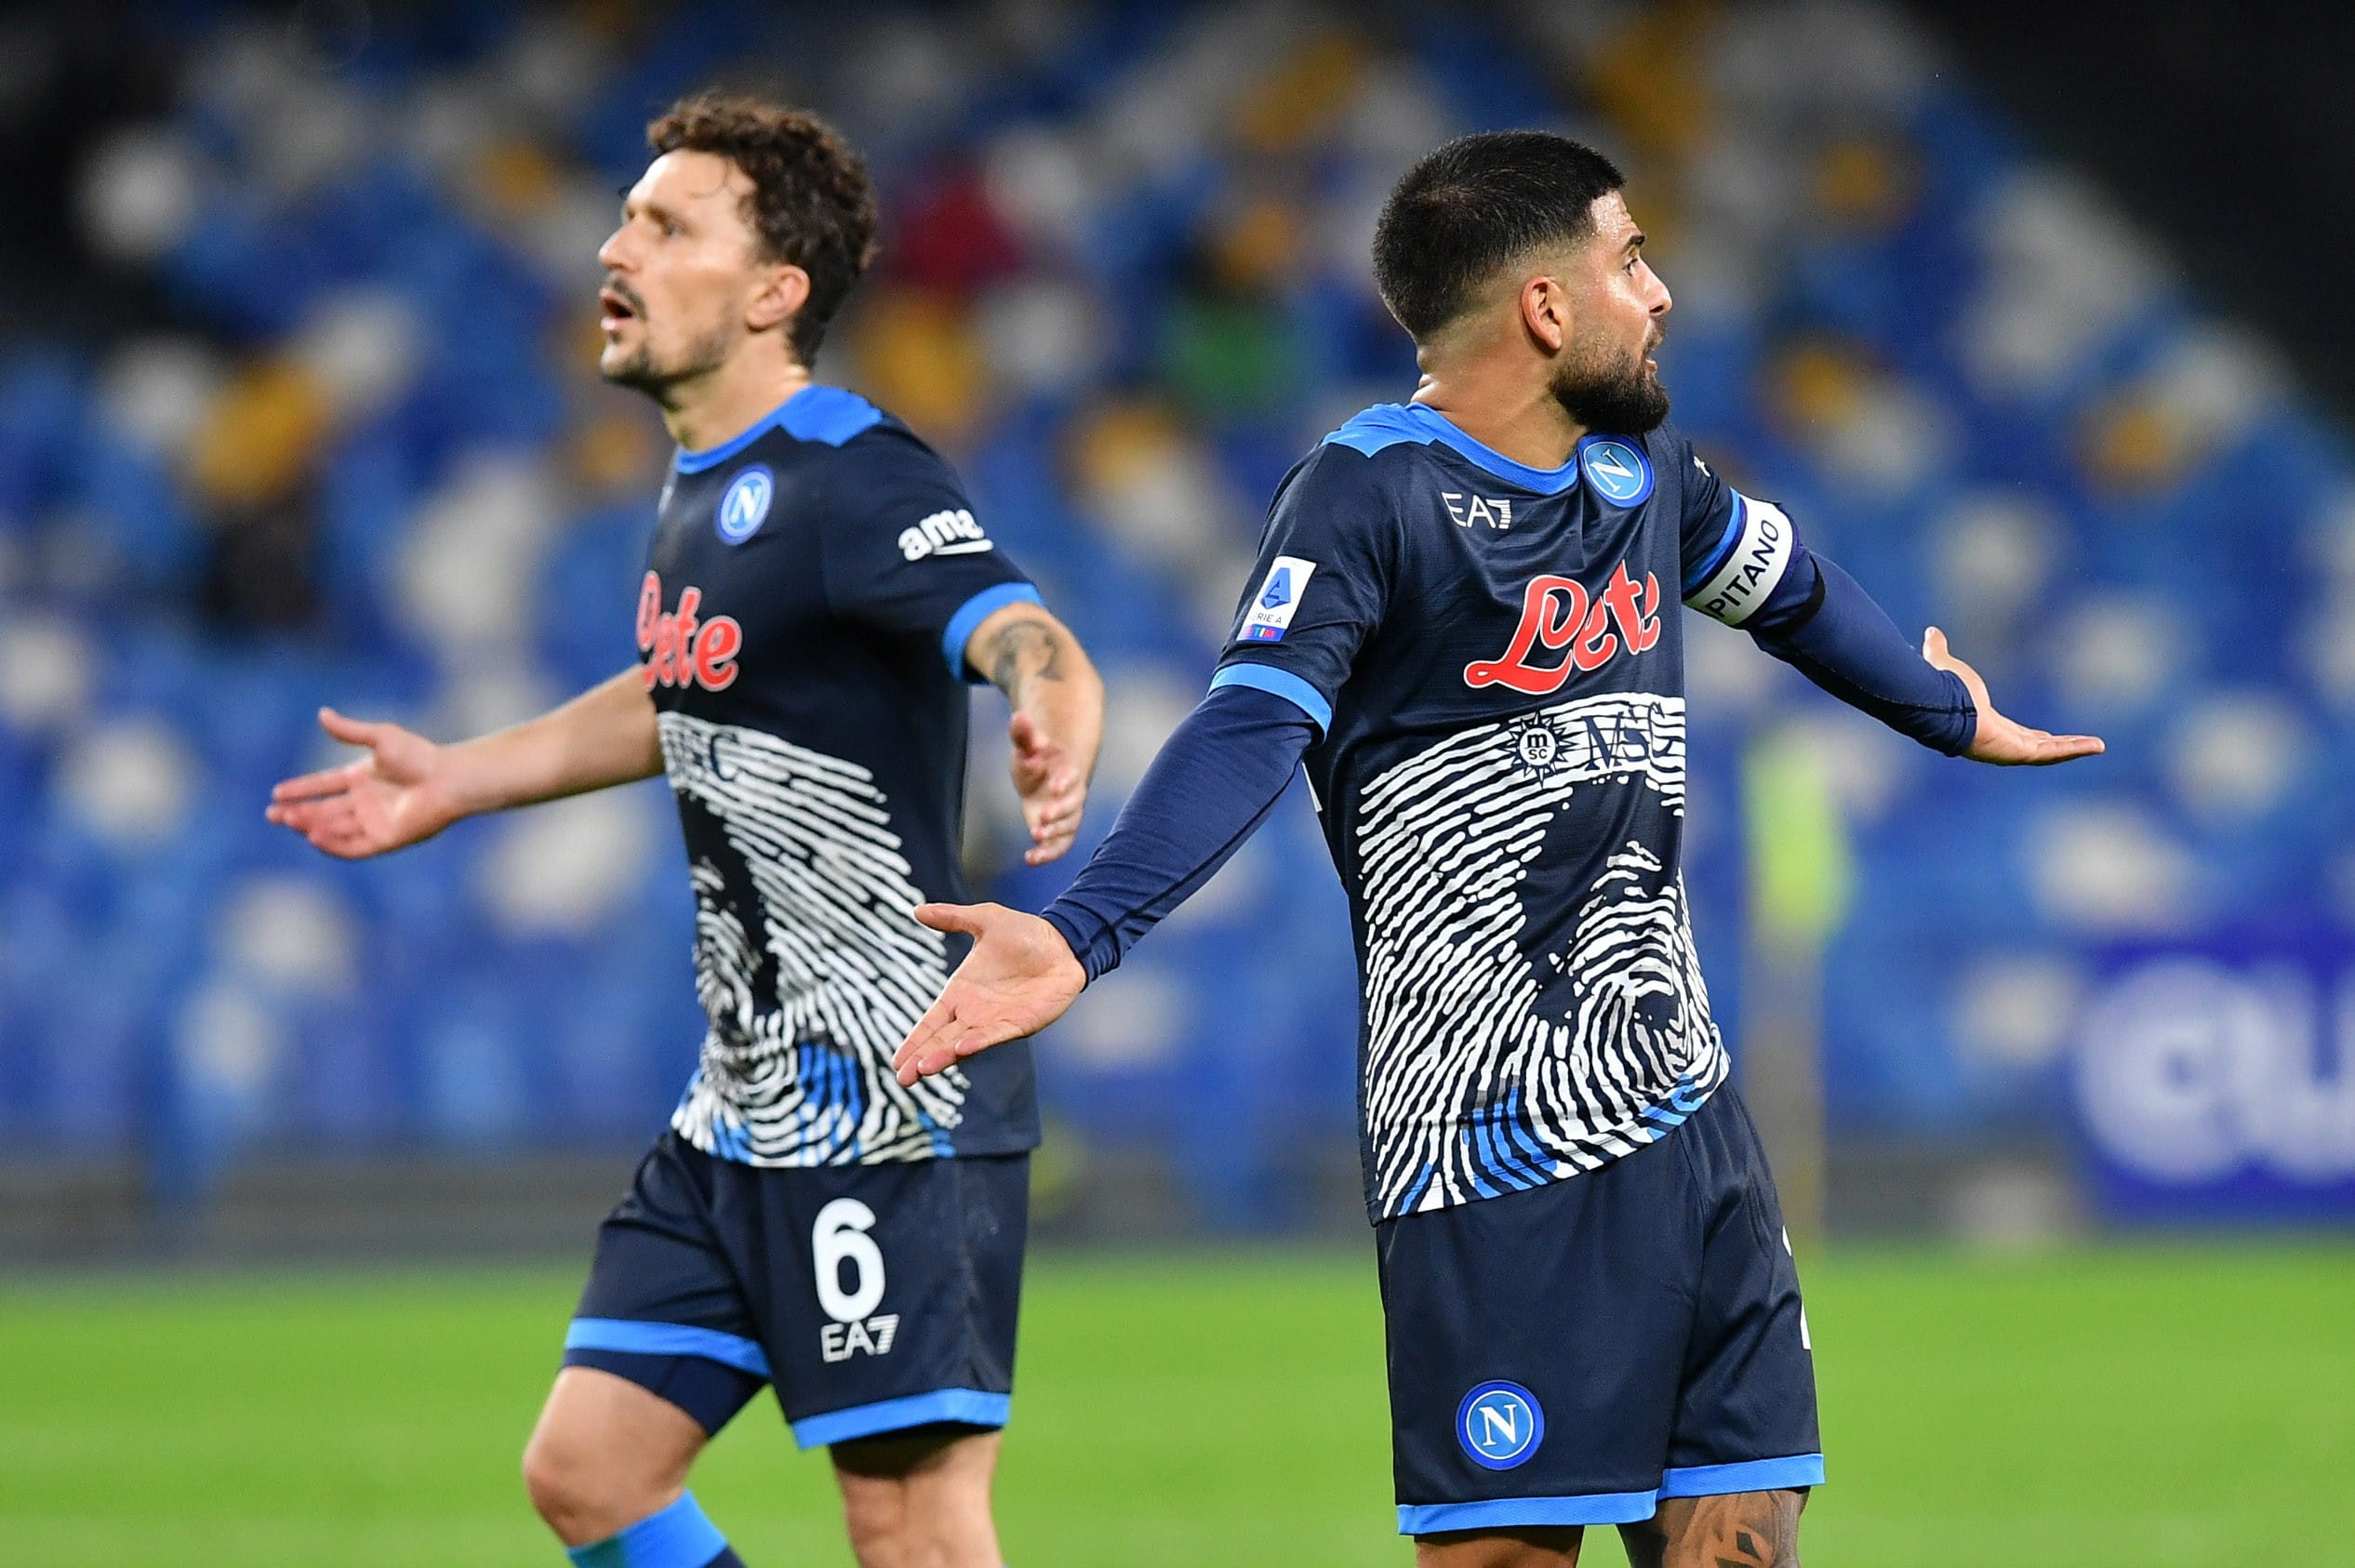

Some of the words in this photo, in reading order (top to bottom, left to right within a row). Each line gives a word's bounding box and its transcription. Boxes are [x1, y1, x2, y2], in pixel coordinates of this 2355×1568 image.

[1590, 448, 1634, 492] N
[1441, 491, 1511, 530] EA7
[812, 1197, 886, 1323] 6
[820, 1313, 900, 1363] EA7
[1478, 1403, 1518, 1446] N
